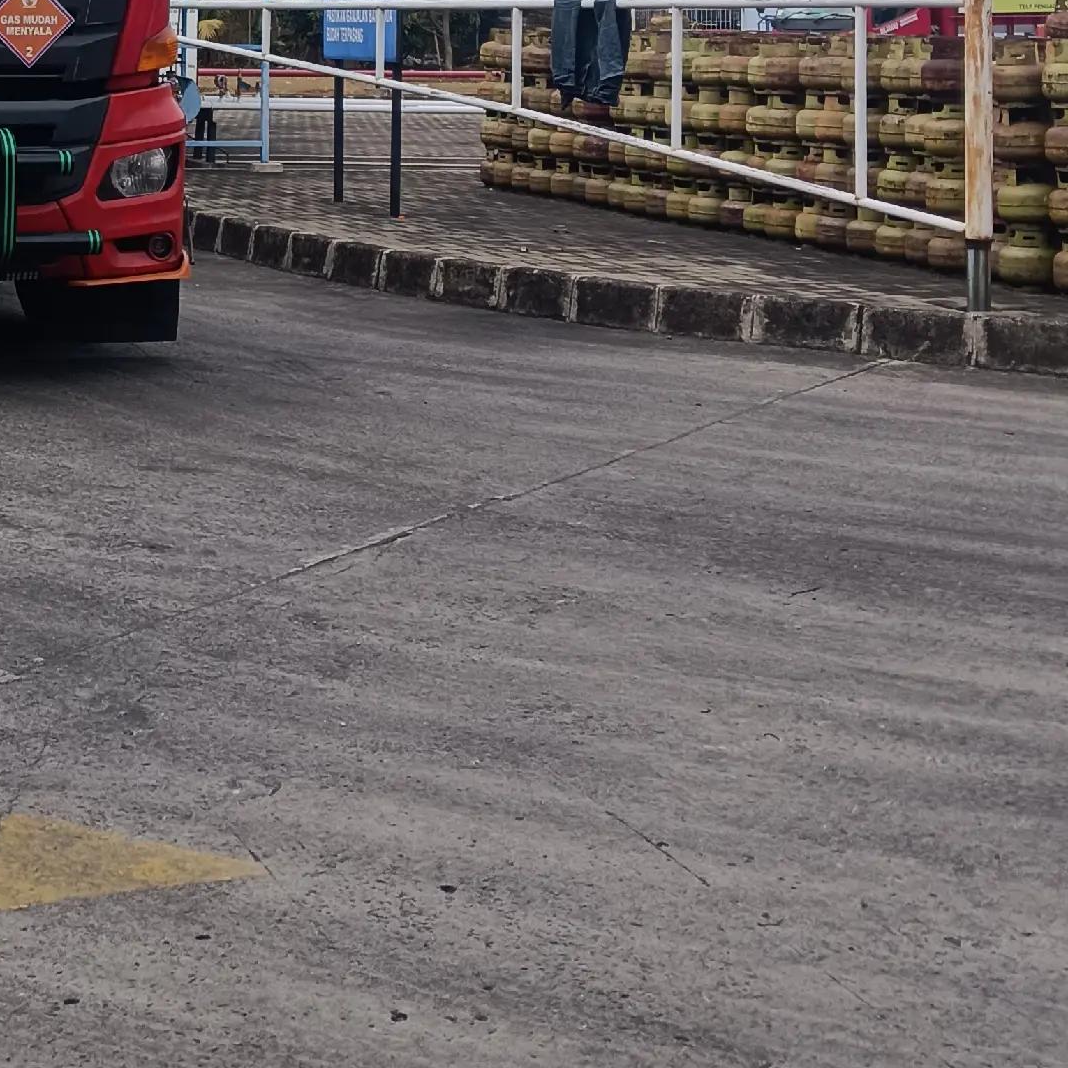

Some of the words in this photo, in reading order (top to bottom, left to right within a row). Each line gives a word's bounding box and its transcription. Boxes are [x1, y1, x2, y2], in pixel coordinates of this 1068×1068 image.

[0, 15, 22, 25] GAS
[23, 15, 58, 25] MUDAH
[6, 27, 53, 36] MENYALA
[25, 46, 33, 58] 2
